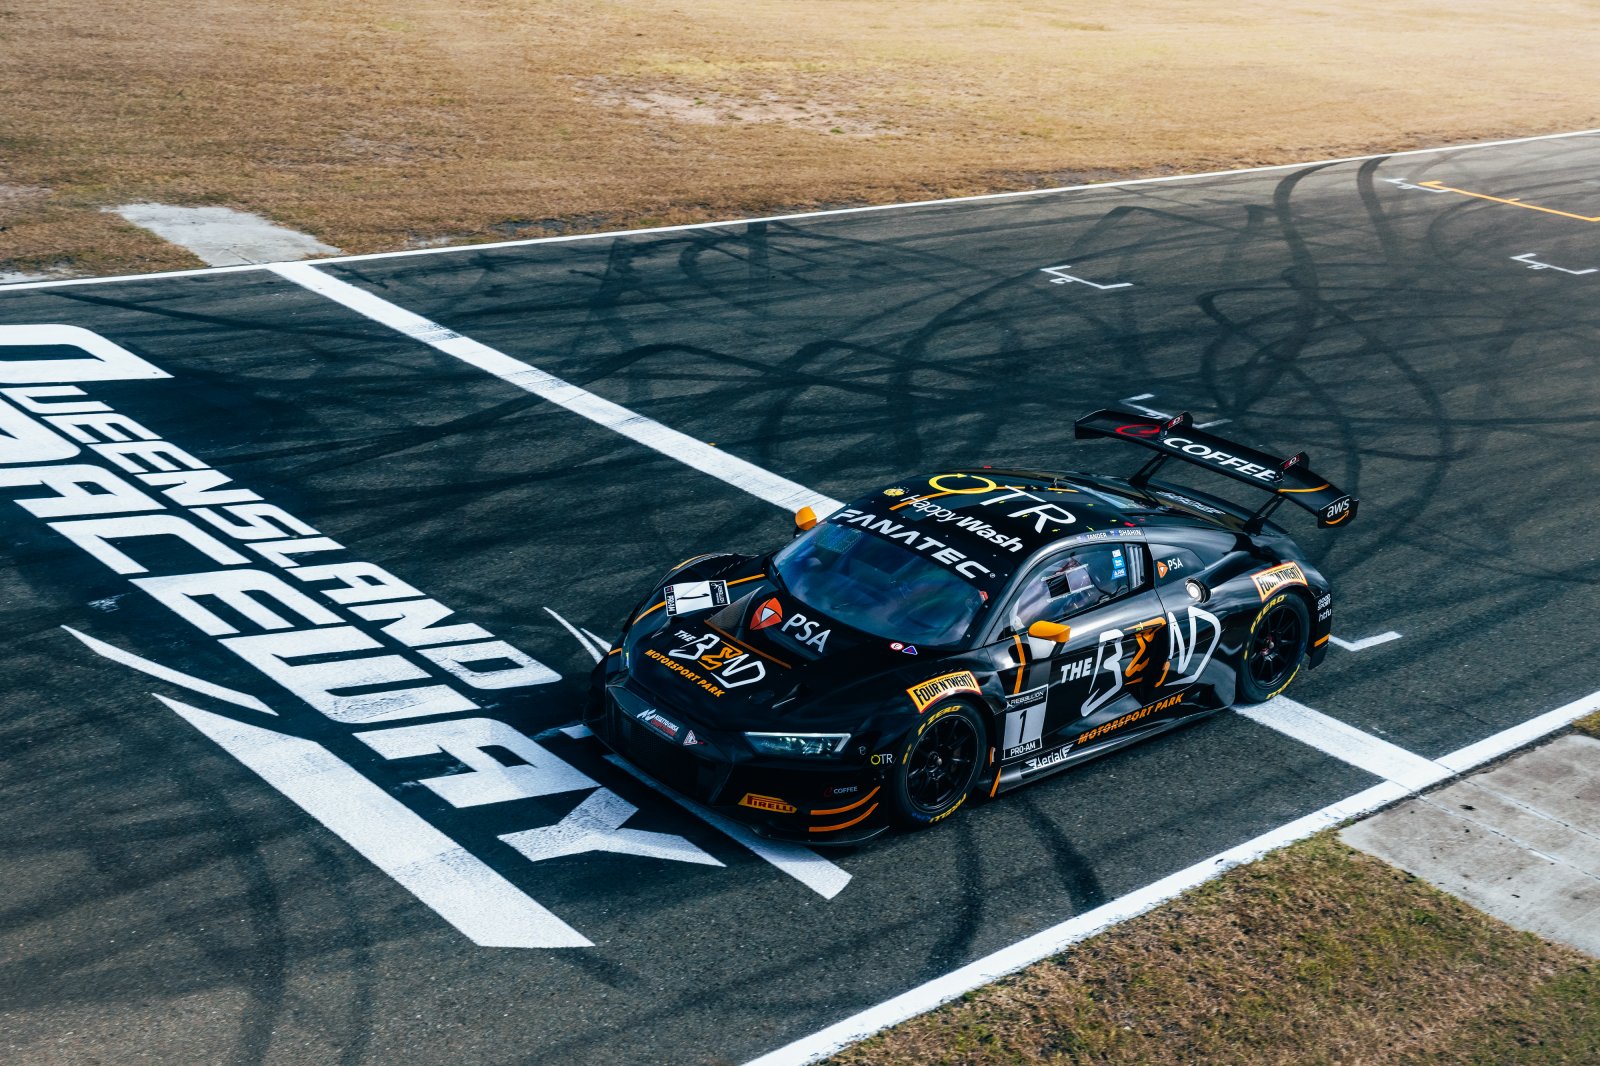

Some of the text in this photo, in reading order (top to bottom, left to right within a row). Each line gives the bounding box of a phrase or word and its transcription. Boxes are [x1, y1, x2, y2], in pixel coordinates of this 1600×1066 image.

[1163, 437, 1278, 482] COFFEE
[929, 473, 1077, 533] OTR
[1326, 498, 1350, 518] aws
[832, 509, 990, 579] FANATEC
[1087, 529, 1142, 541] TANDER SHAHIN
[1167, 557, 1183, 571] PSA
[0, 395, 727, 867] ACEWAY
[781, 612, 831, 655] PSA
[644, 649, 726, 698] MOTORSPORT PARK
[668, 630, 766, 688] THE BEND
[1060, 656, 1093, 684] THE
[1019, 709, 1028, 744] 1
[1077, 693, 1185, 745] MOTORSPORT PARK
[870, 753, 893, 765] OTR
[1010, 740, 1036, 757] PRO-AM
[745, 793, 796, 813] PIRELLI
[833, 785, 858, 795] COFFEE
